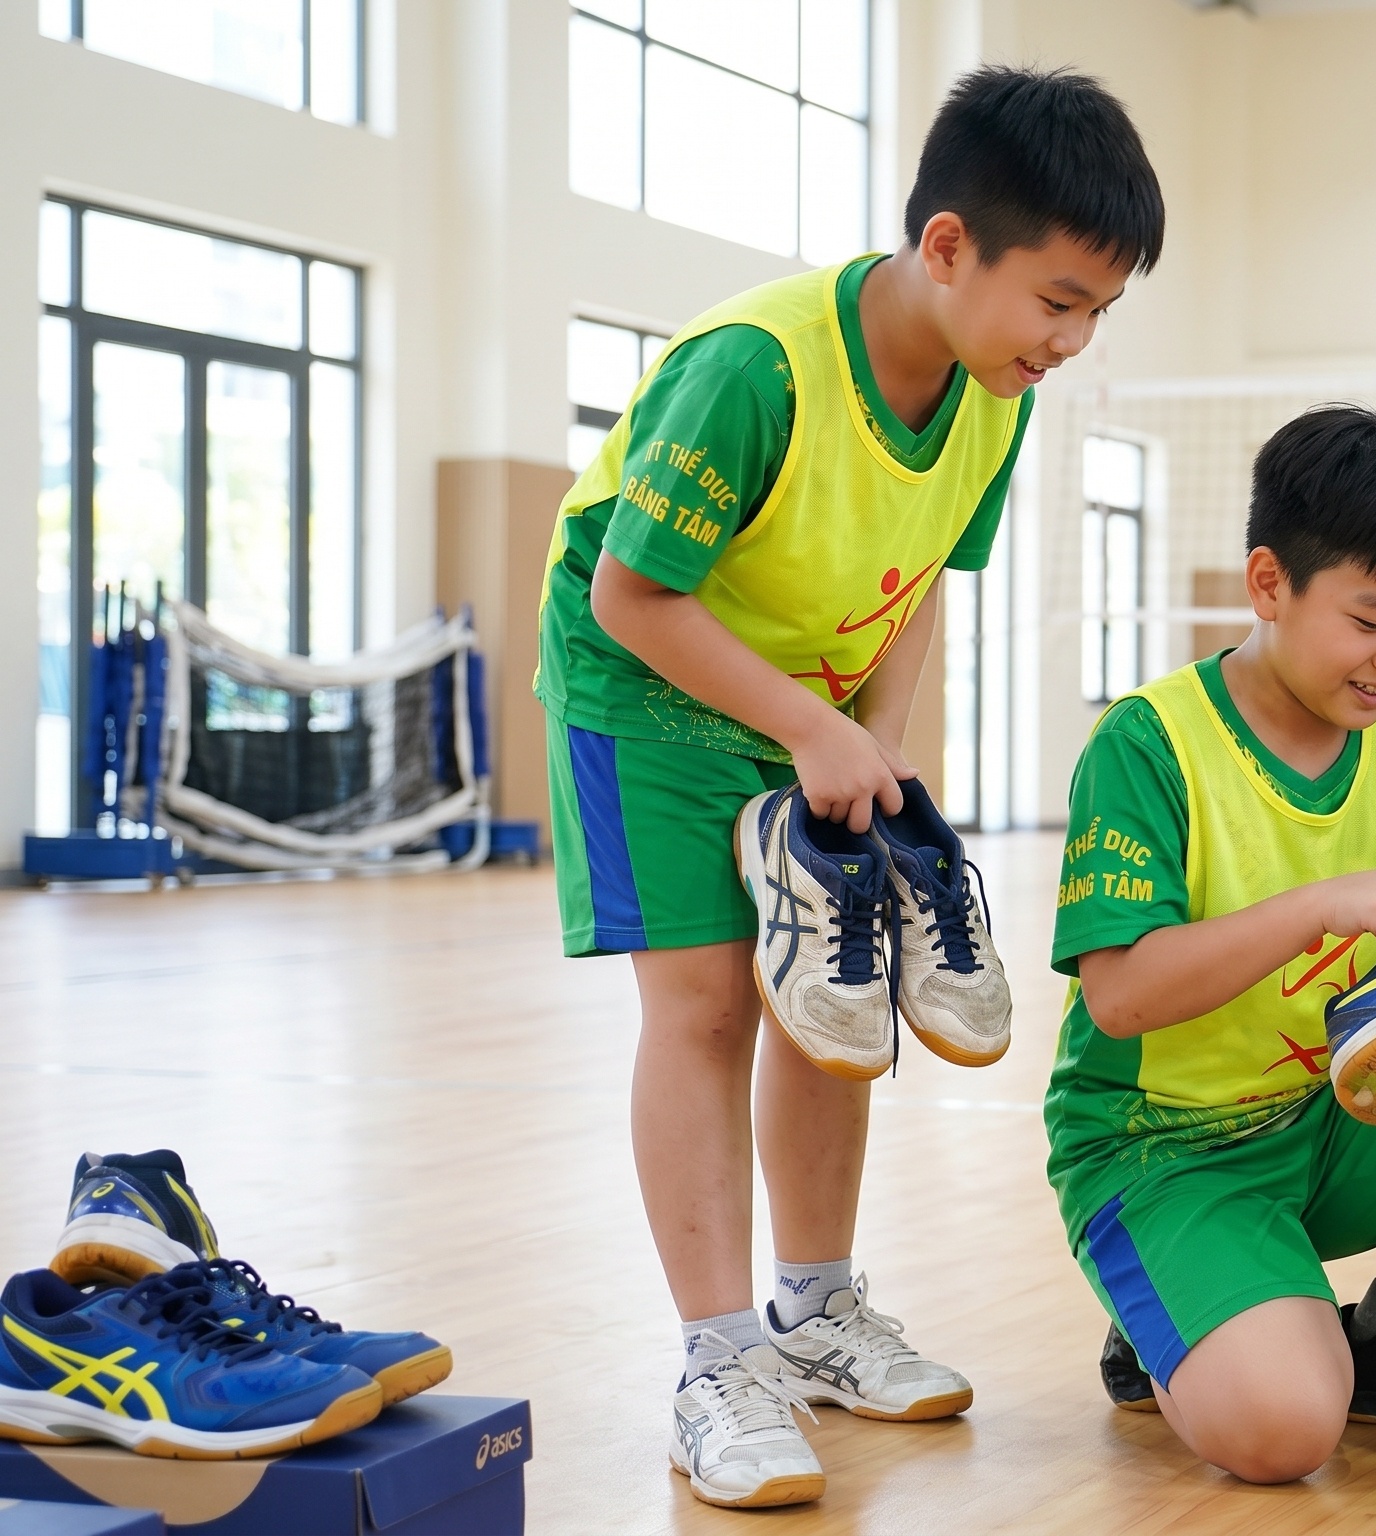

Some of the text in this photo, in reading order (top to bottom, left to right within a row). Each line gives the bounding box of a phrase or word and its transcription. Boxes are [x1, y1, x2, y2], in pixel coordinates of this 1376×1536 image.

[698, 466, 738, 511] DỤC
[1103, 828, 1152, 867] DỤC
[1102, 870, 1153, 902] TÂM
[491, 1426, 523, 1458] asics
